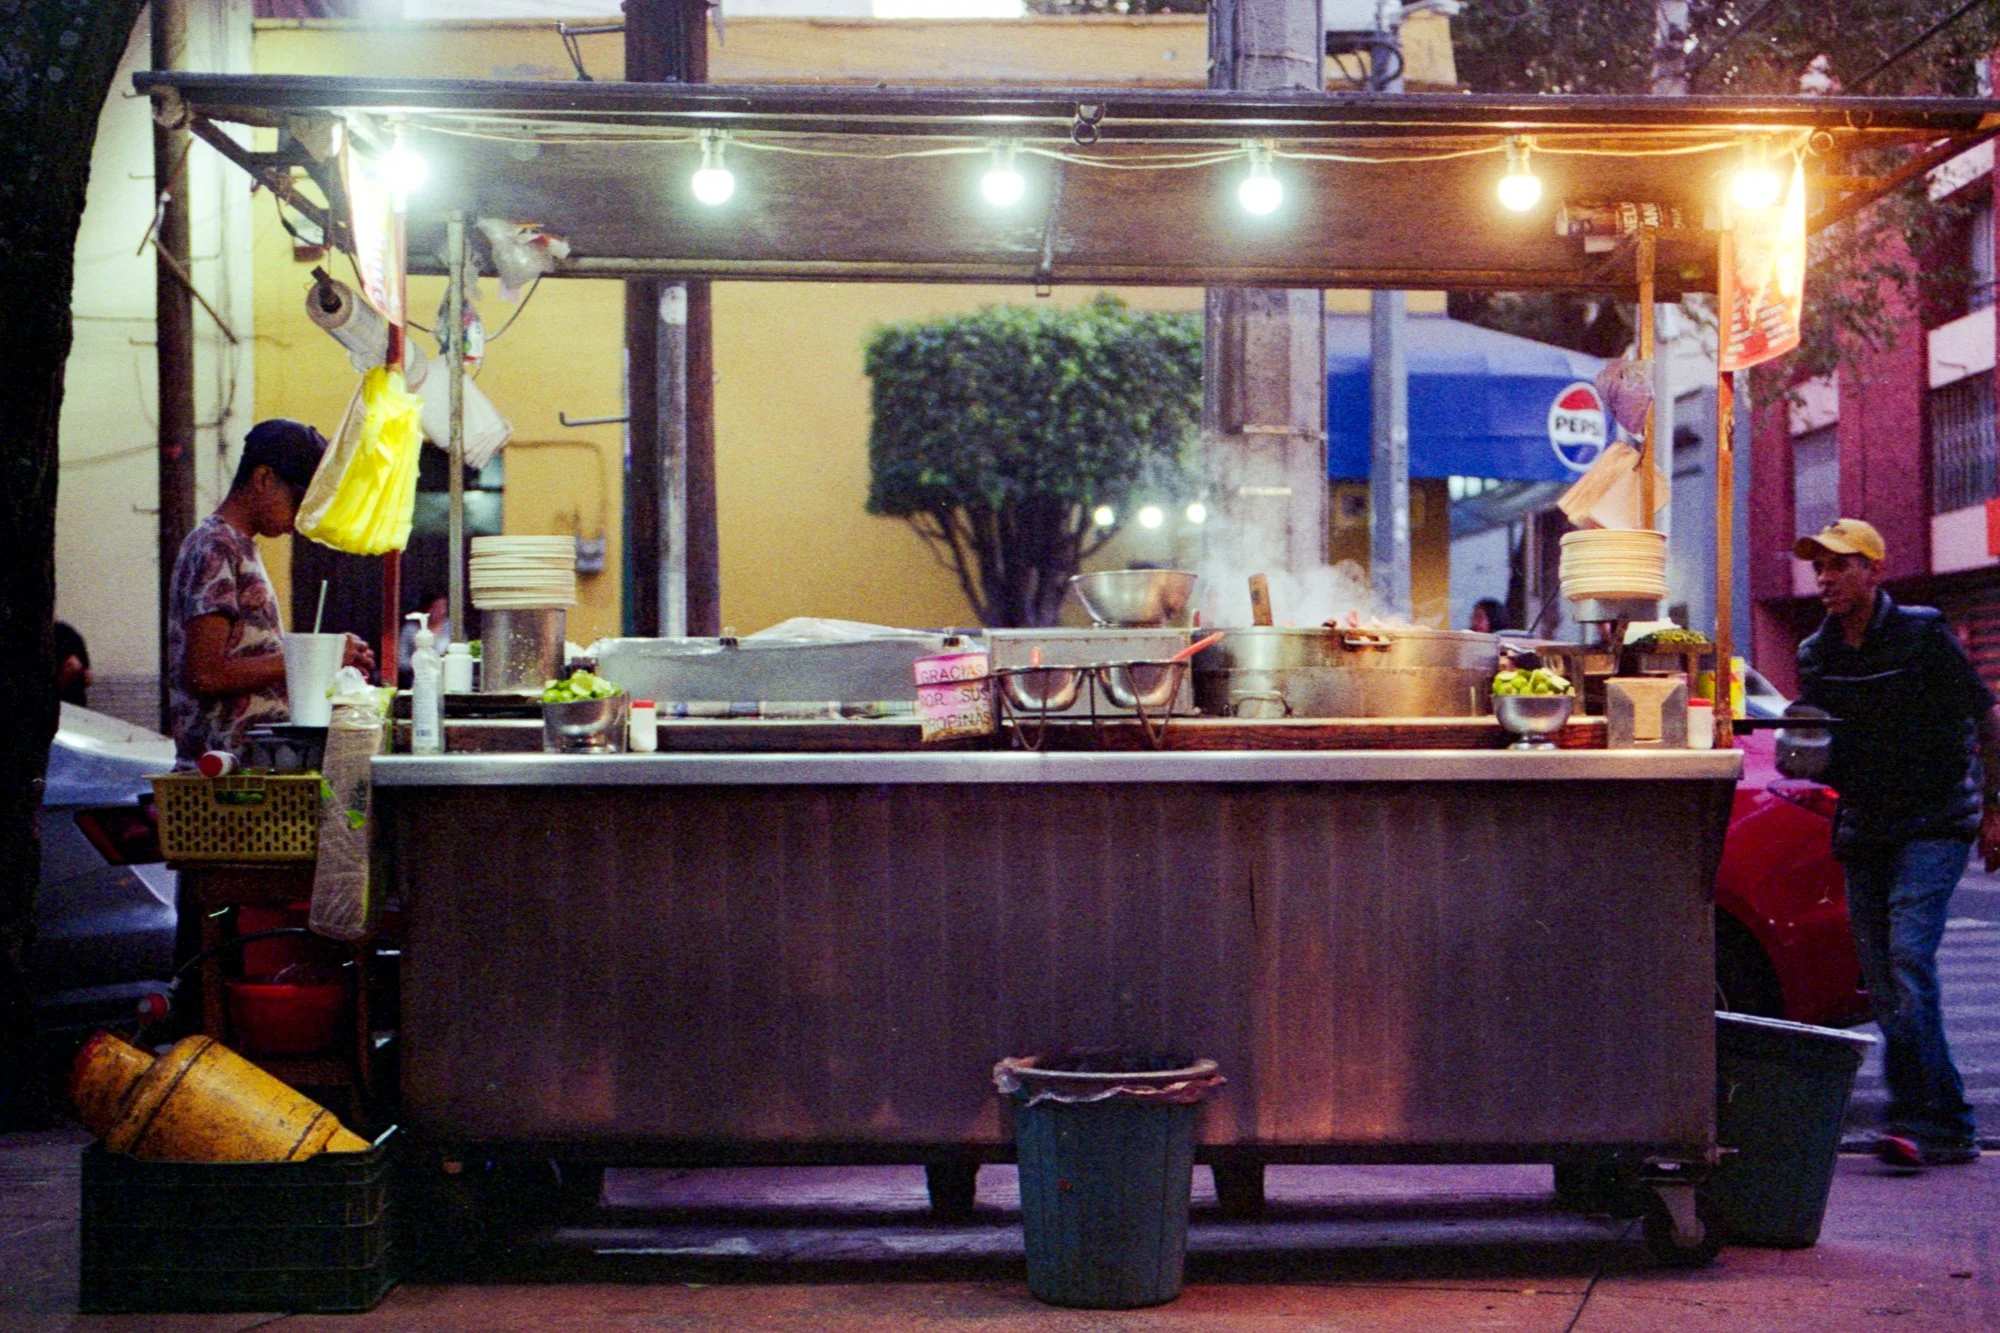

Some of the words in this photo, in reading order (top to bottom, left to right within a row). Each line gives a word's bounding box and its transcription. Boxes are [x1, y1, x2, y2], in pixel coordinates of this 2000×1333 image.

[1555, 414, 1602, 437] PEPS
[921, 664, 985, 683] GRACIAS
[961, 686, 990, 703] SUS
